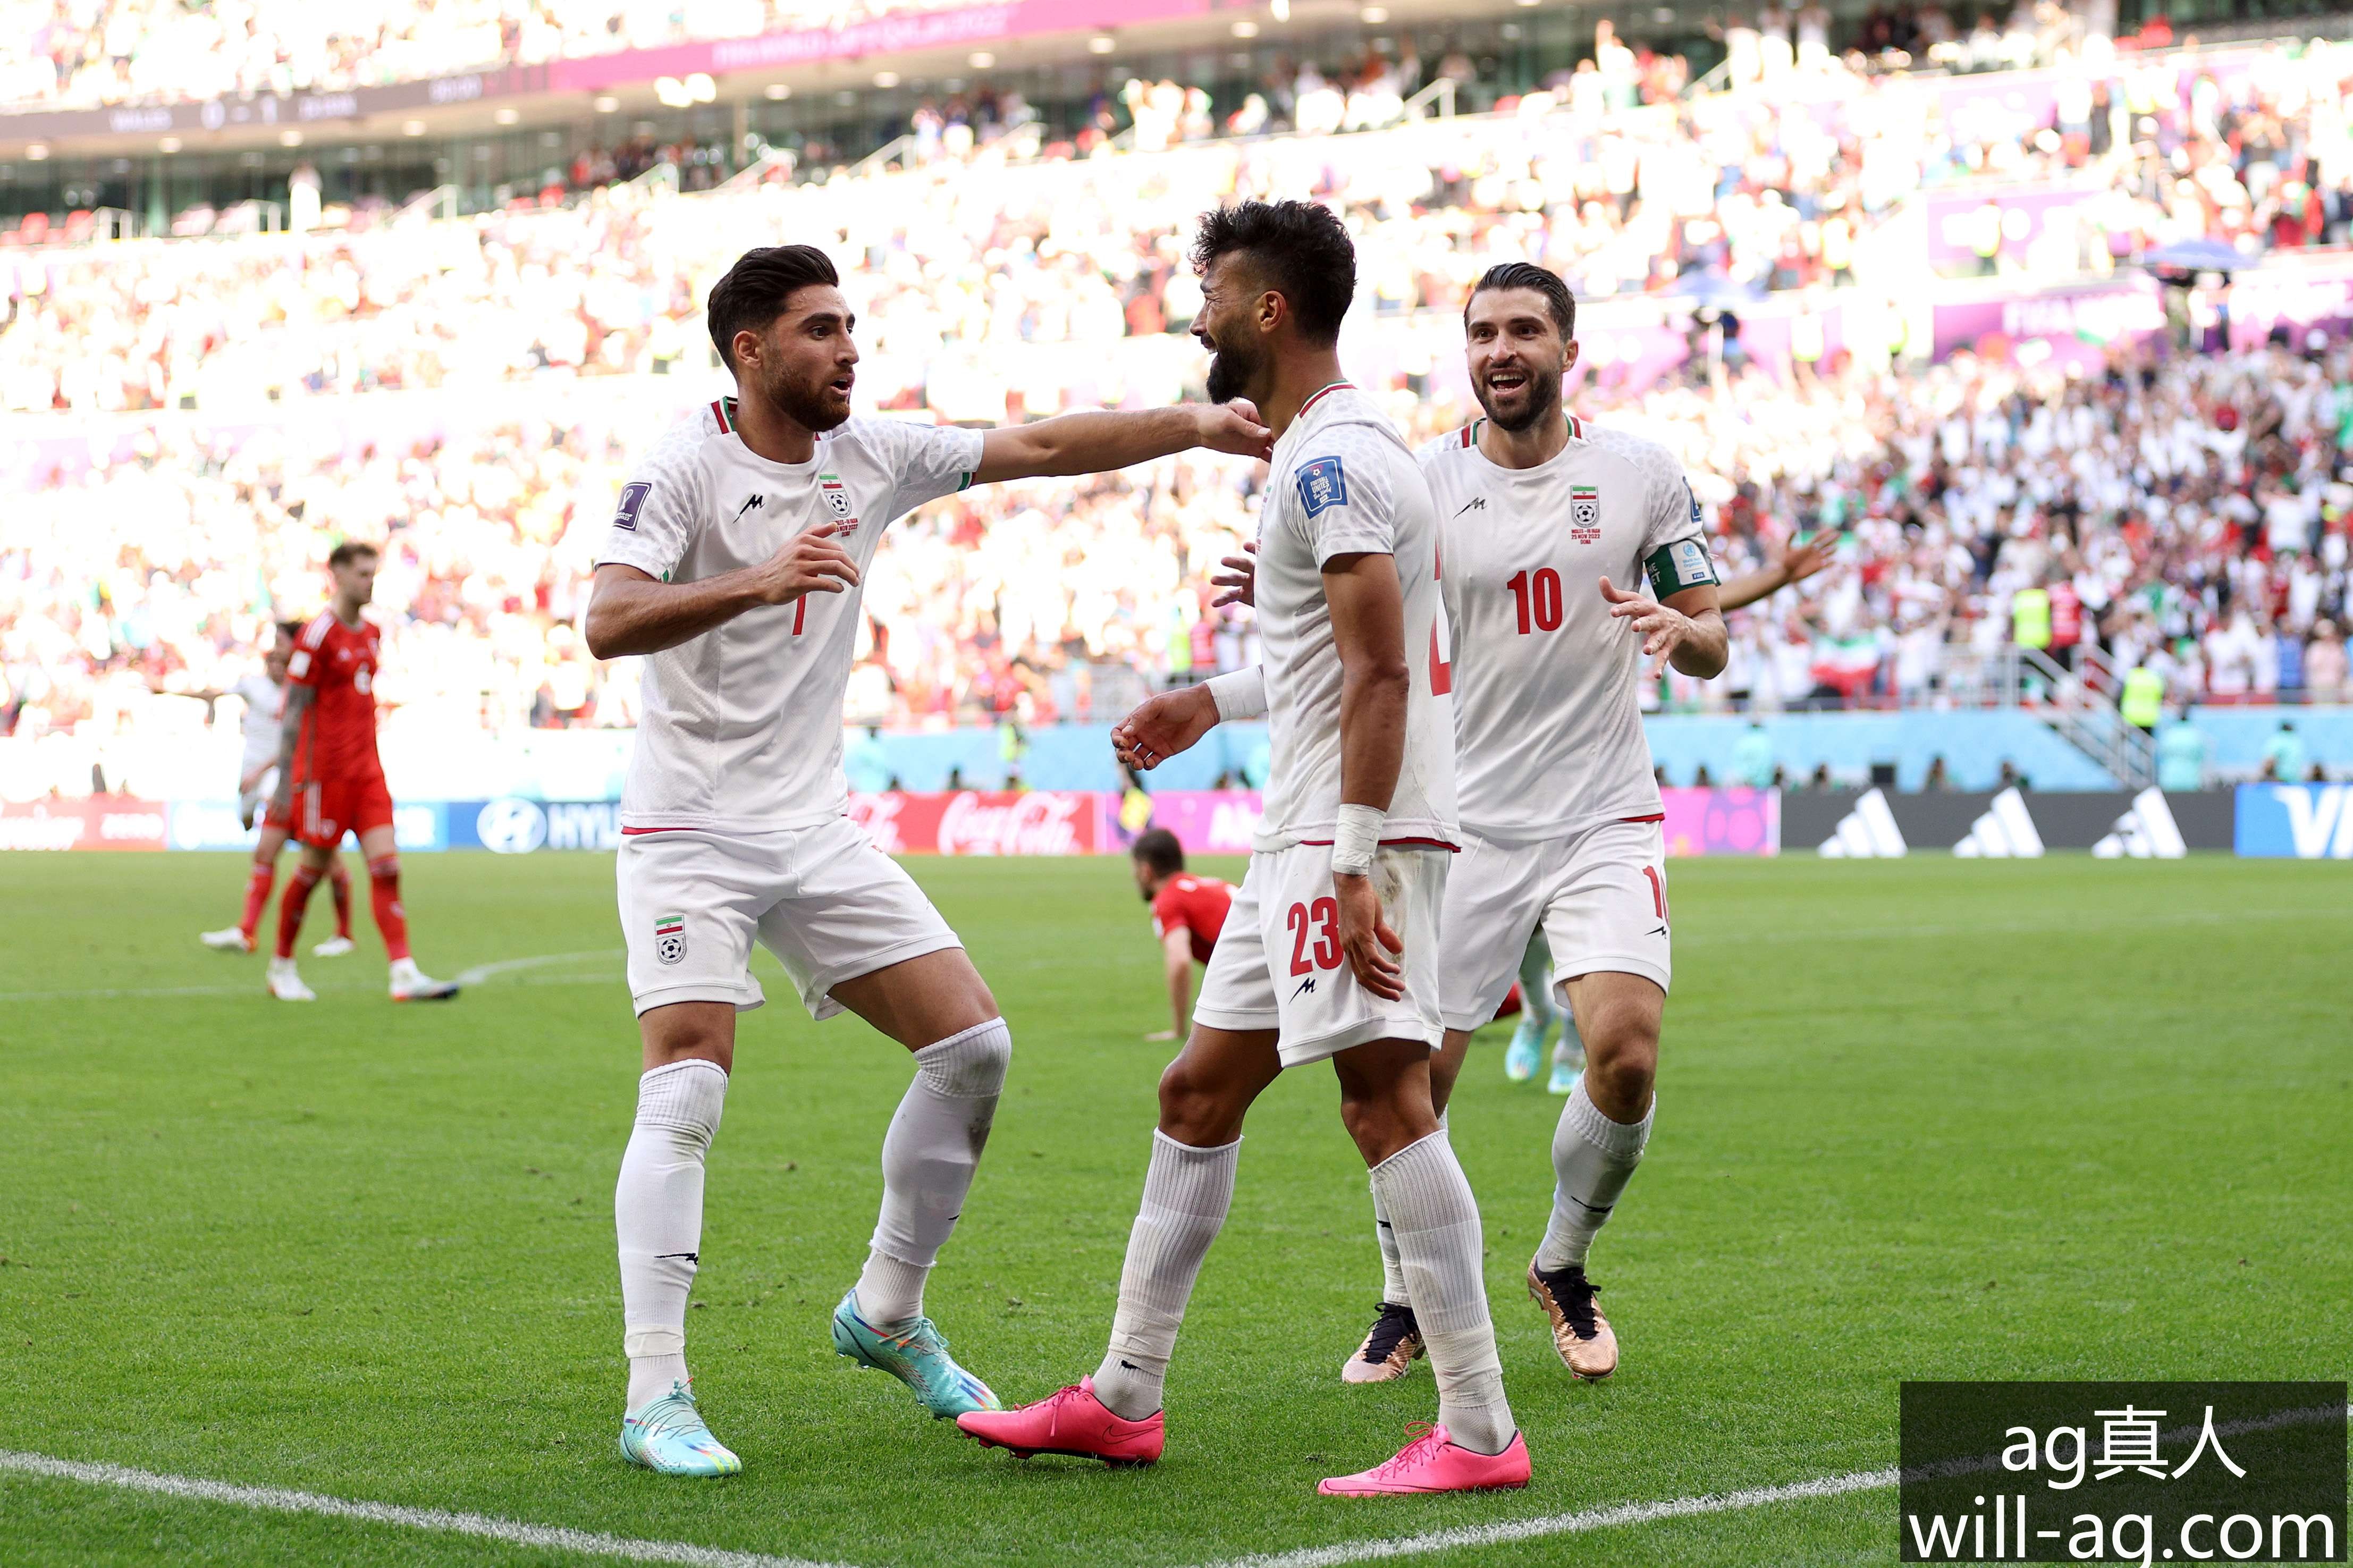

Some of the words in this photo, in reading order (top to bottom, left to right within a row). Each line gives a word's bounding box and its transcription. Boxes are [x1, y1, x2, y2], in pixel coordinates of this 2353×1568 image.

[1310, 476, 1329, 487] FOOTBALL
[1311, 480, 1330, 494] UNITES
[1506, 567, 1564, 635] 10
[1287, 896, 1344, 977] 23
